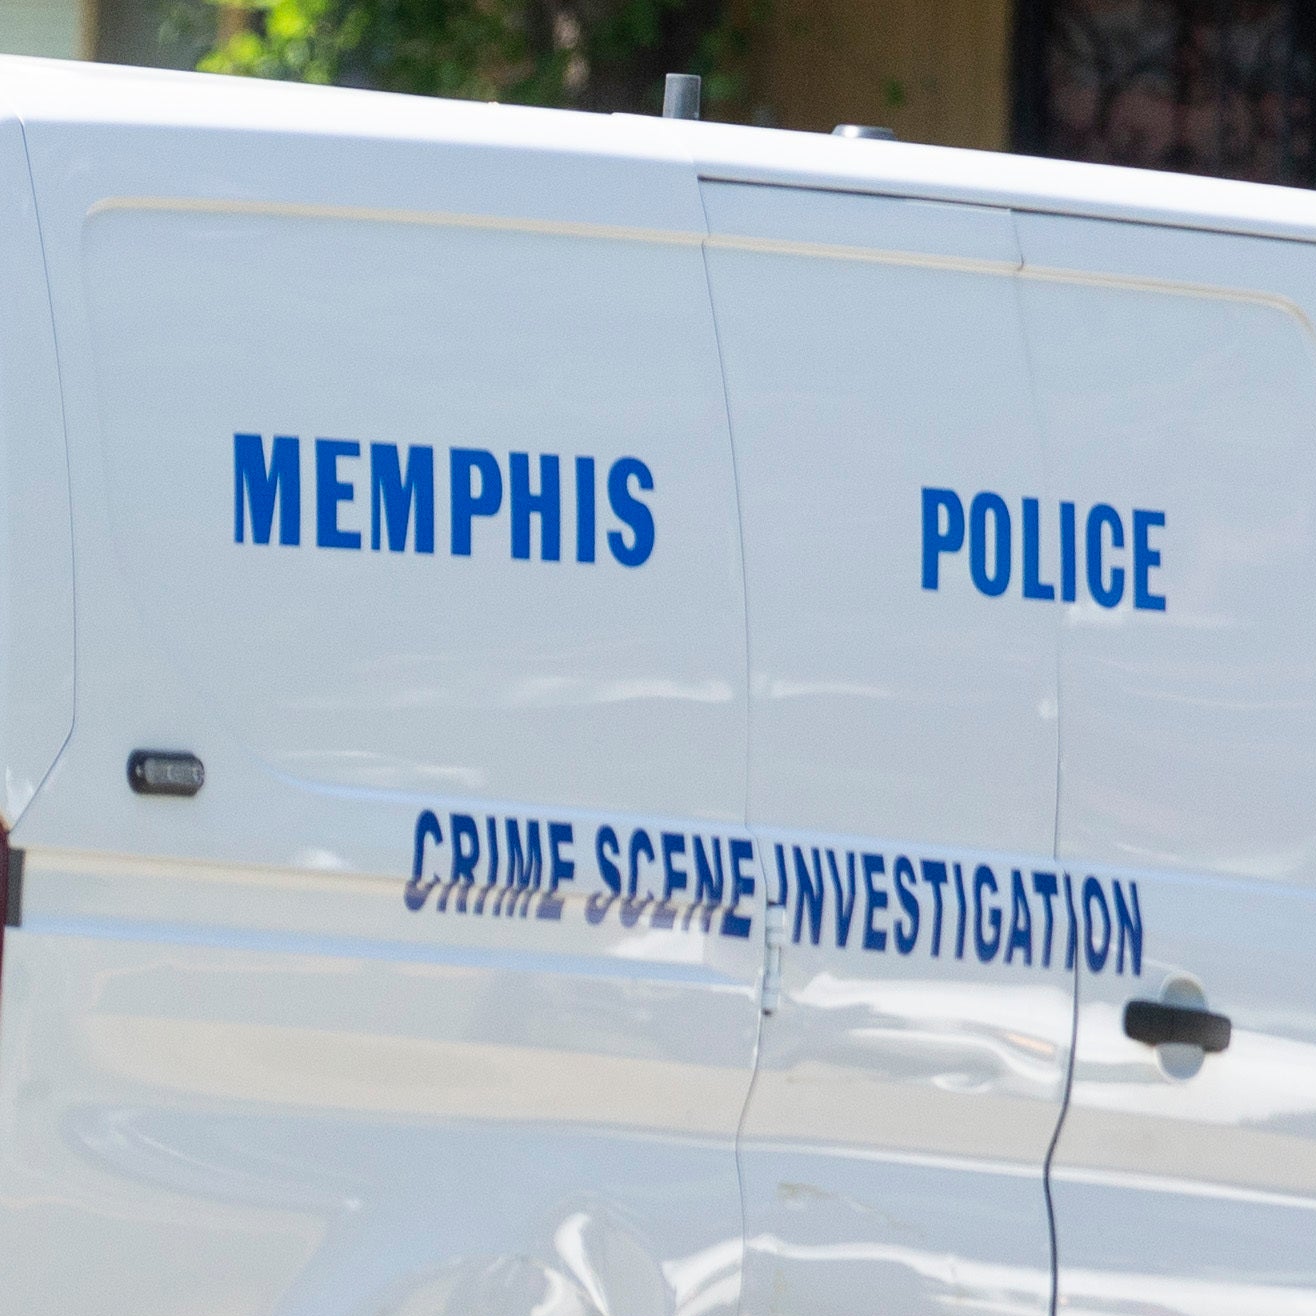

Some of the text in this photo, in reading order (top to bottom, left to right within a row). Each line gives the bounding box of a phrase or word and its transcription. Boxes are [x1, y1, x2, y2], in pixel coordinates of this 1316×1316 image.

[233, 432, 1167, 612] MEMPHIS POLICE
[403, 809, 1143, 977] CRIME SCENE INVESTIGATION
